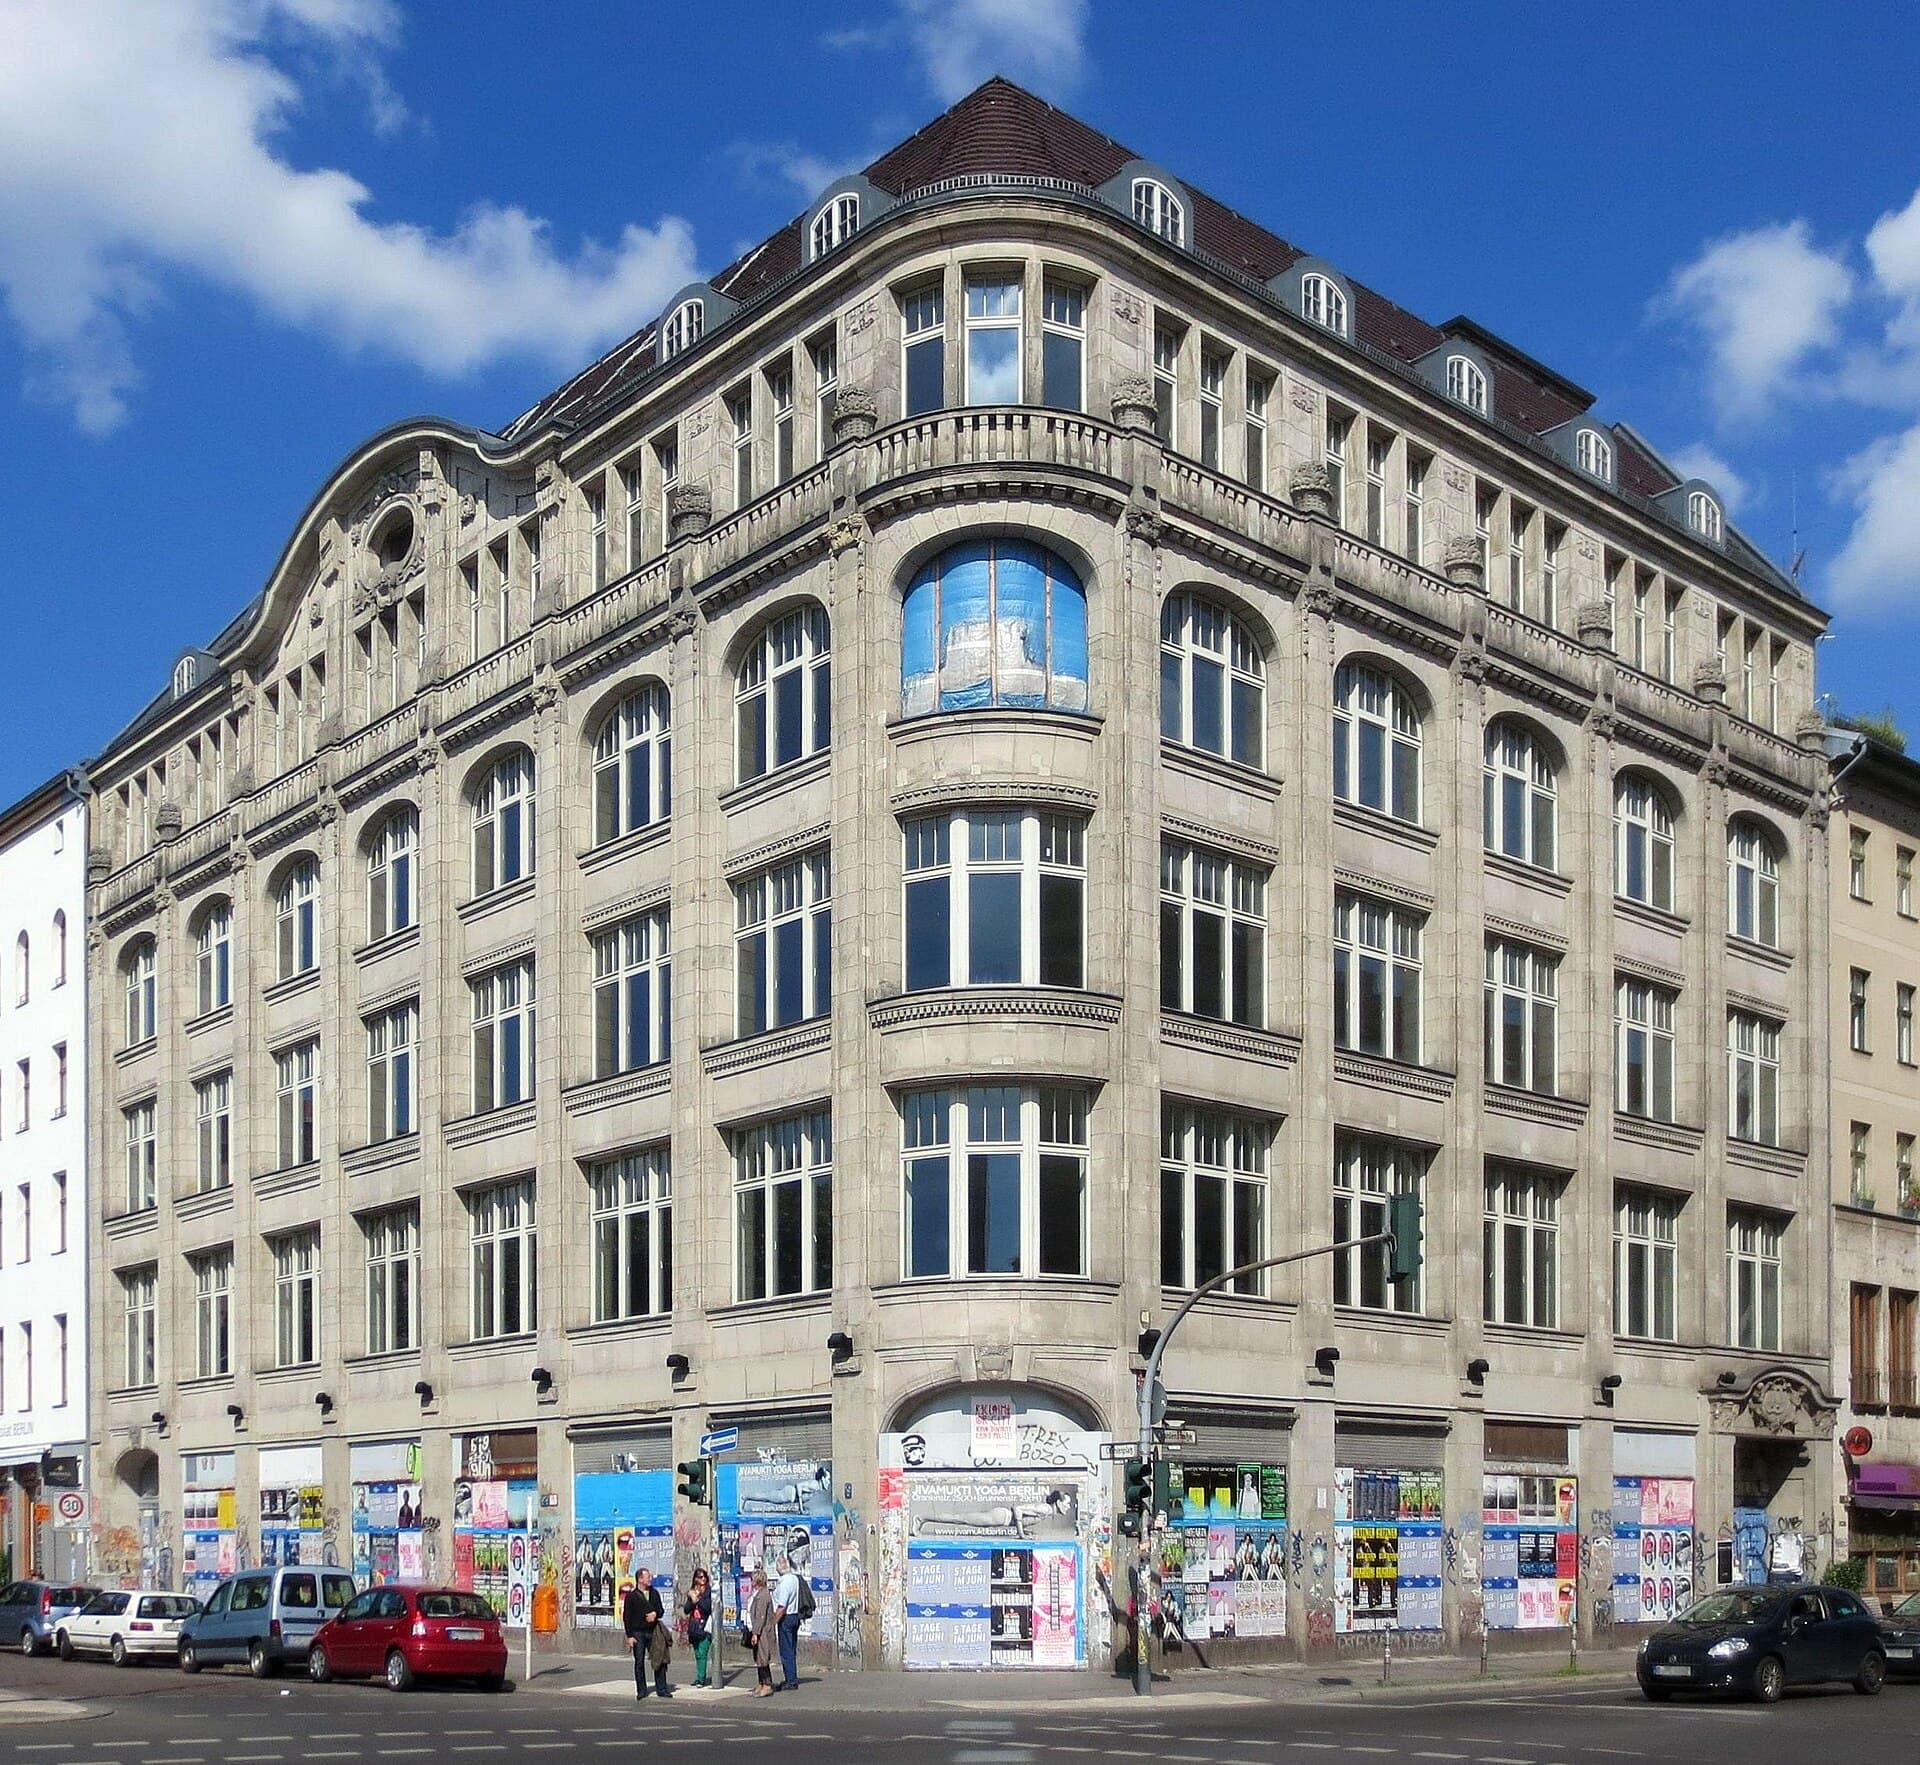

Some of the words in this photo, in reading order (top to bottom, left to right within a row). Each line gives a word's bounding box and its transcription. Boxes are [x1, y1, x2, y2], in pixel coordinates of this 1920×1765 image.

[1019, 1443, 1066, 1466] BOZO
[774, 1464, 792, 1475] YOGA
[793, 1463, 818, 1474] BERLIN
[911, 1484, 972, 1496] JIVAMUKTI
[974, 1486, 1006, 1496] YOGA
[1010, 1486, 1050, 1496] BERLIN
[64, 1500, 78, 1512] 30
[920, 1564, 940, 1575] TAGE
[962, 1565, 982, 1575] TAGE
[912, 1576, 923, 1585] IM
[924, 1574, 945, 1585] JUNI
[954, 1576, 965, 1586] IM
[966, 1574, 986, 1585] JUNI
[920, 1622, 940, 1632] TAGE
[961, 1624, 982, 1633] TAGE
[912, 1634, 923, 1644] IM
[924, 1632, 945, 1642] JUNI
[954, 1635, 964, 1644] IM
[966, 1634, 986, 1643] JUNI
